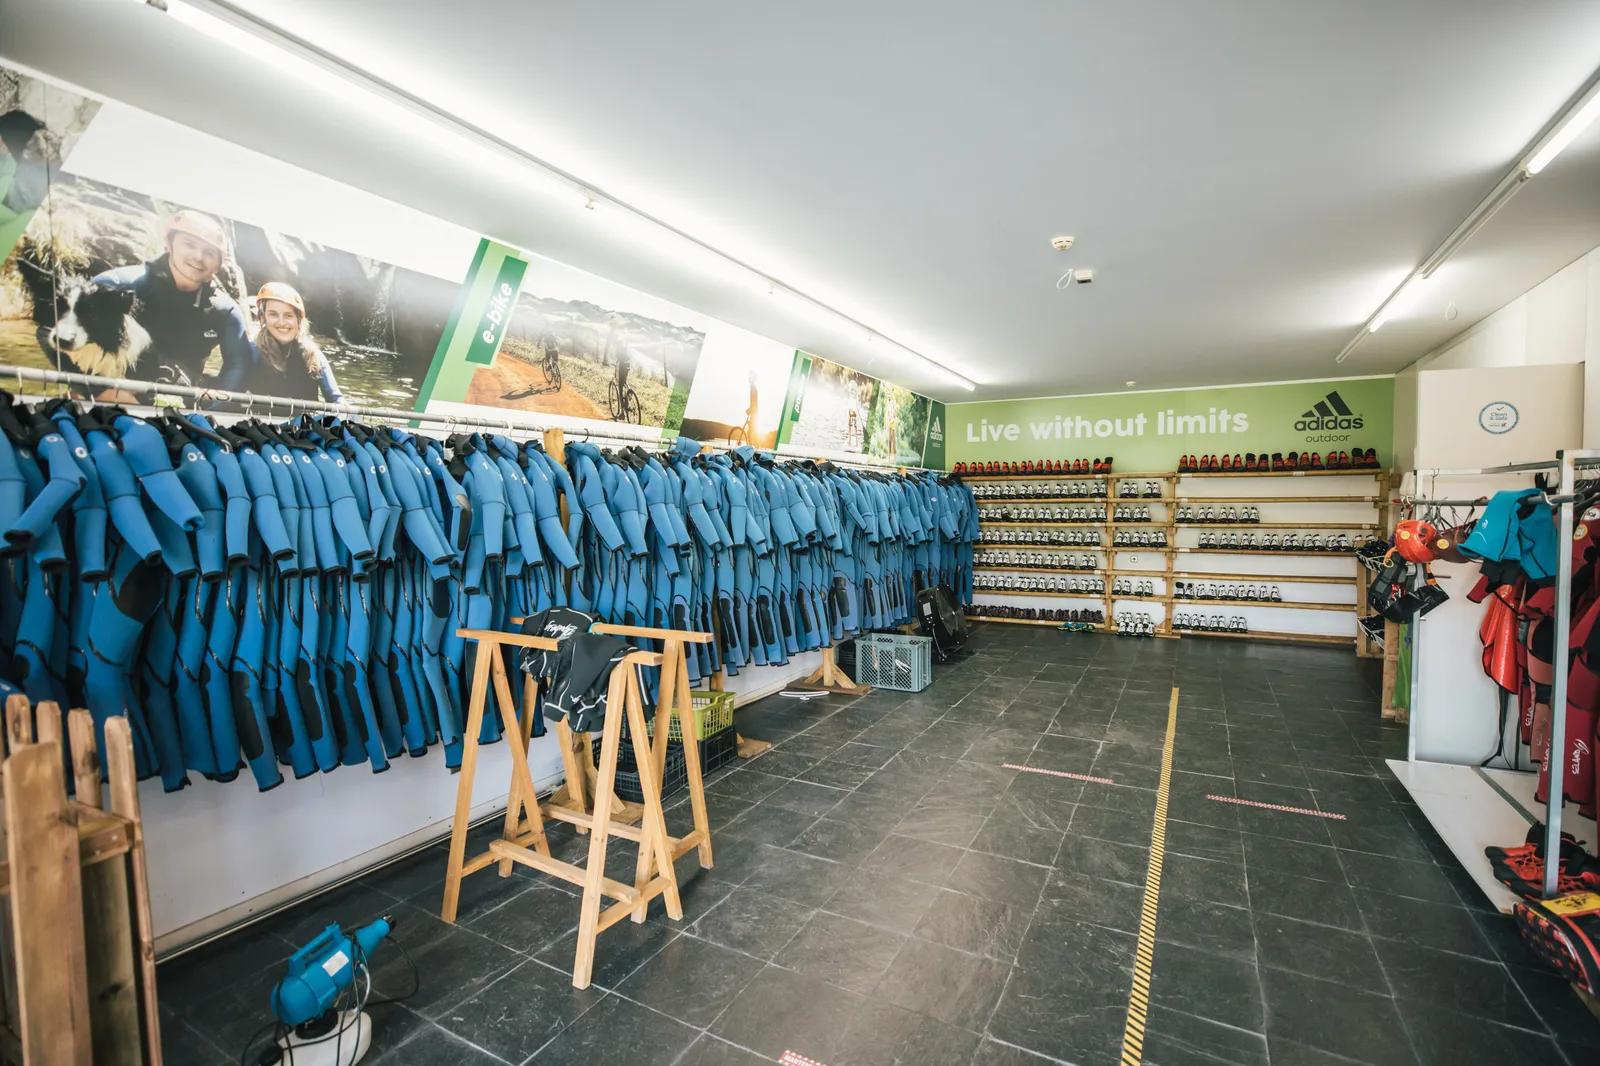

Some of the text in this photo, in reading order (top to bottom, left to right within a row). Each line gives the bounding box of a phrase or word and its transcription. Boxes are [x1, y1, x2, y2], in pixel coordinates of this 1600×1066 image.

[482, 282, 512, 344] e-bike
[967, 407, 1249, 444] Live without limits
[1294, 415, 1364, 432] adidas
[1305, 433, 1351, 443] outdoor
